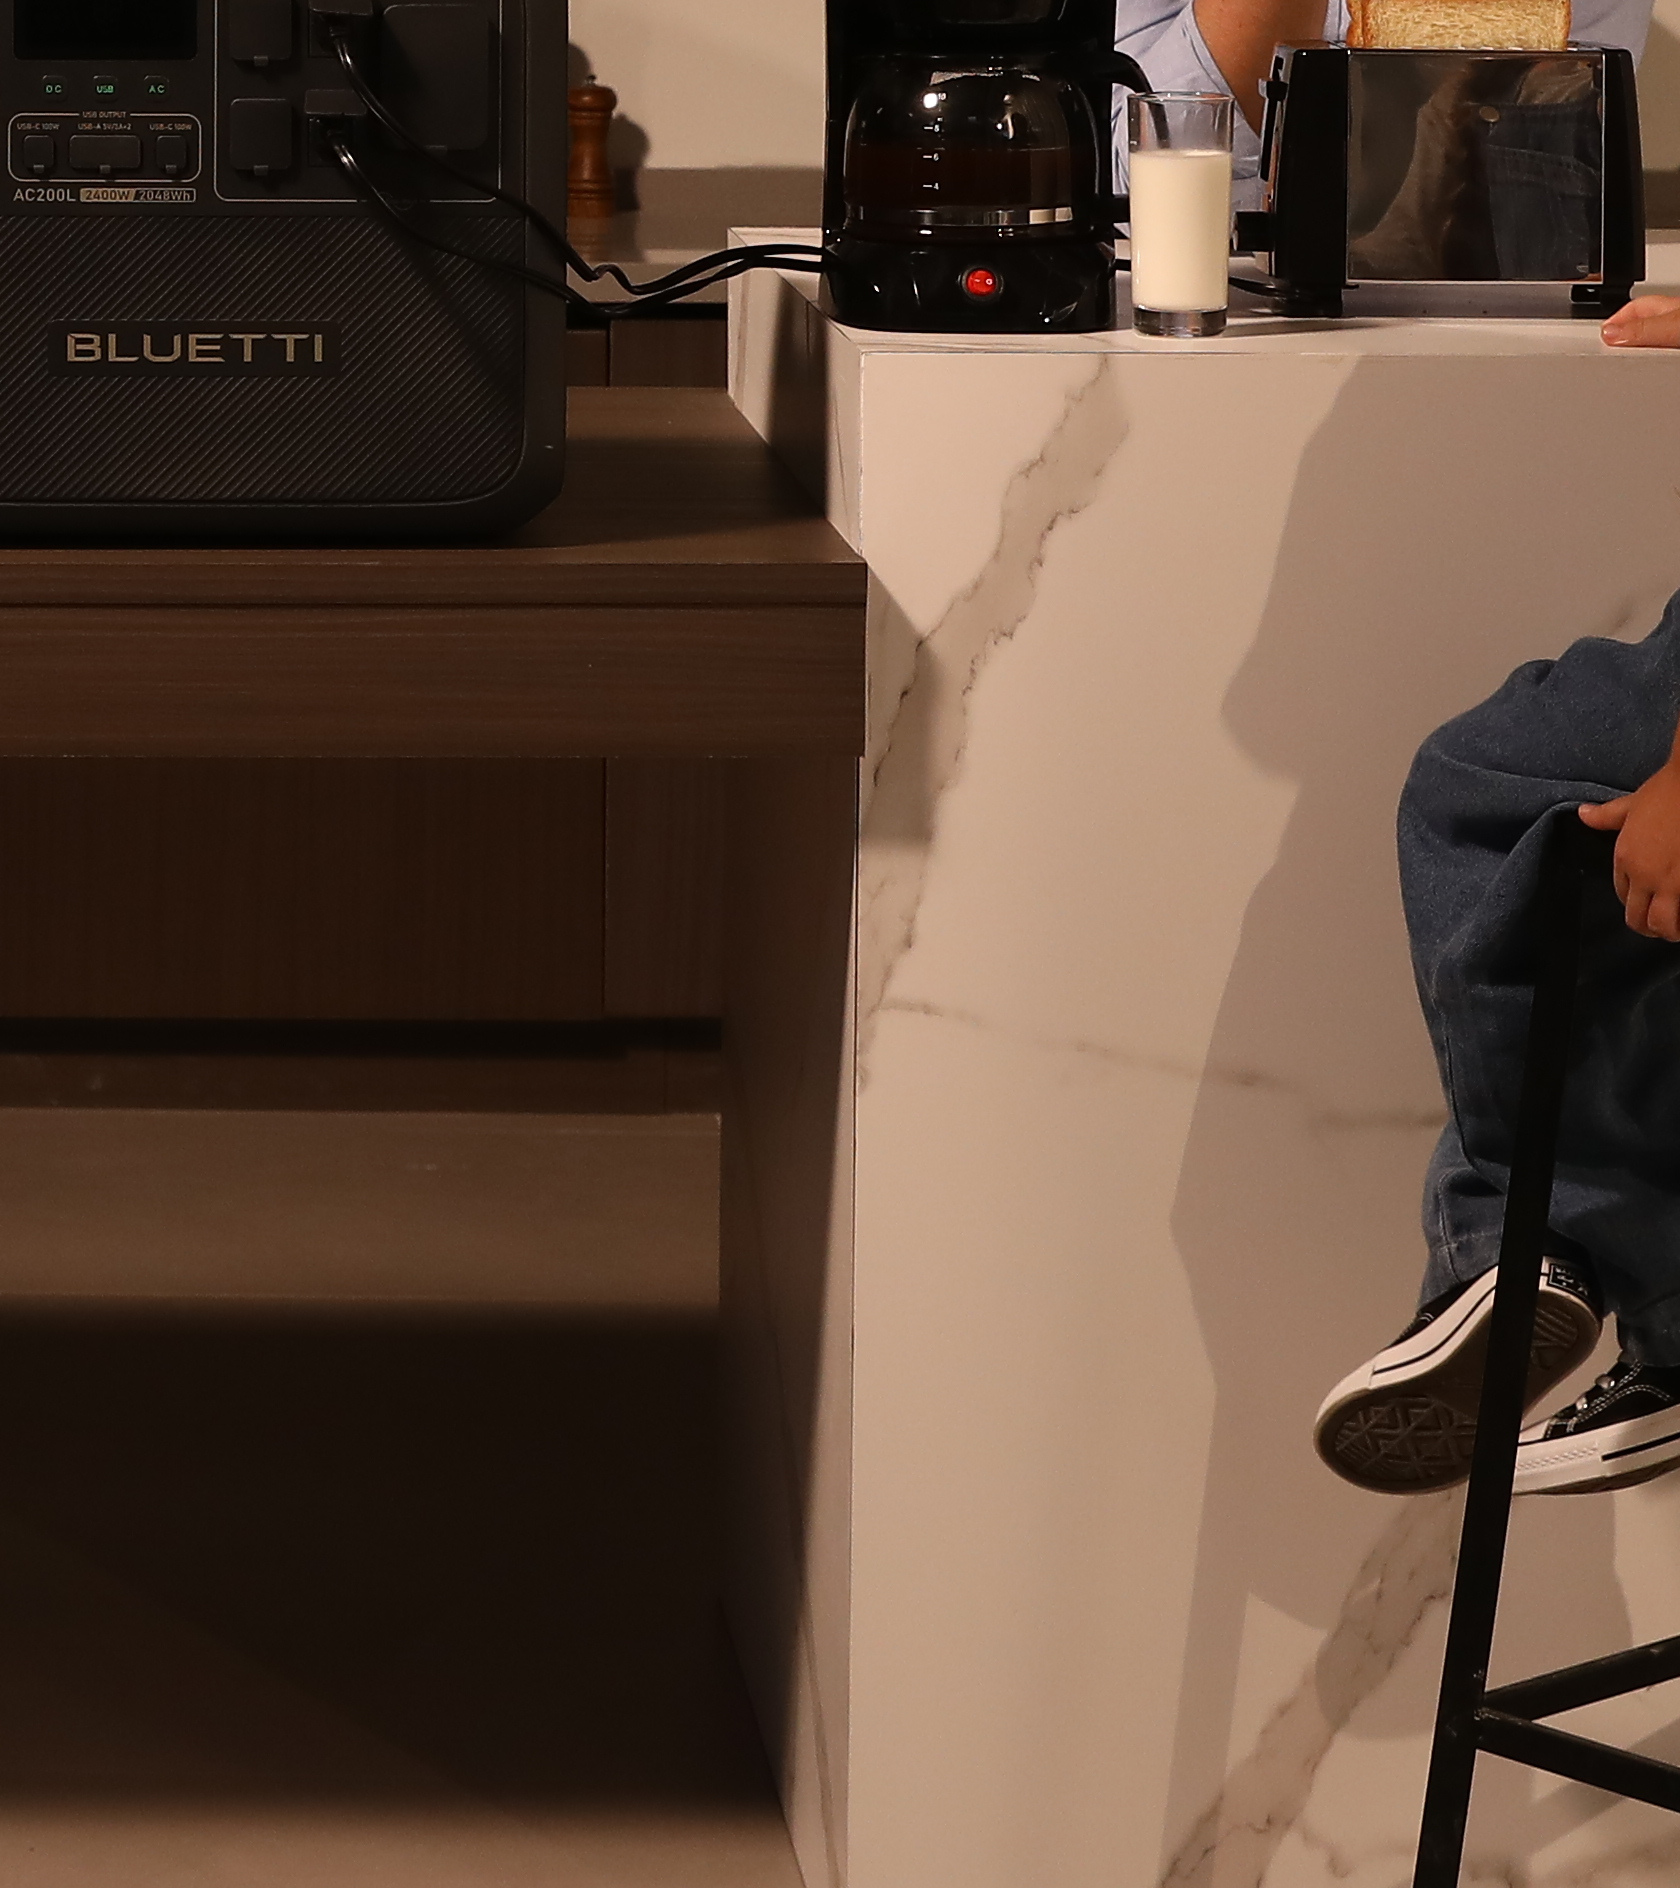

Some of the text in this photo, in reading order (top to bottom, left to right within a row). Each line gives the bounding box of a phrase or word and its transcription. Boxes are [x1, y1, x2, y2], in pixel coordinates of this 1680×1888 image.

[96, 84, 115, 93] USB
[13, 188, 76, 202] AC200L
[85, 189, 132, 201] 2400W
[66, 332, 324, 363] BLUETTI
